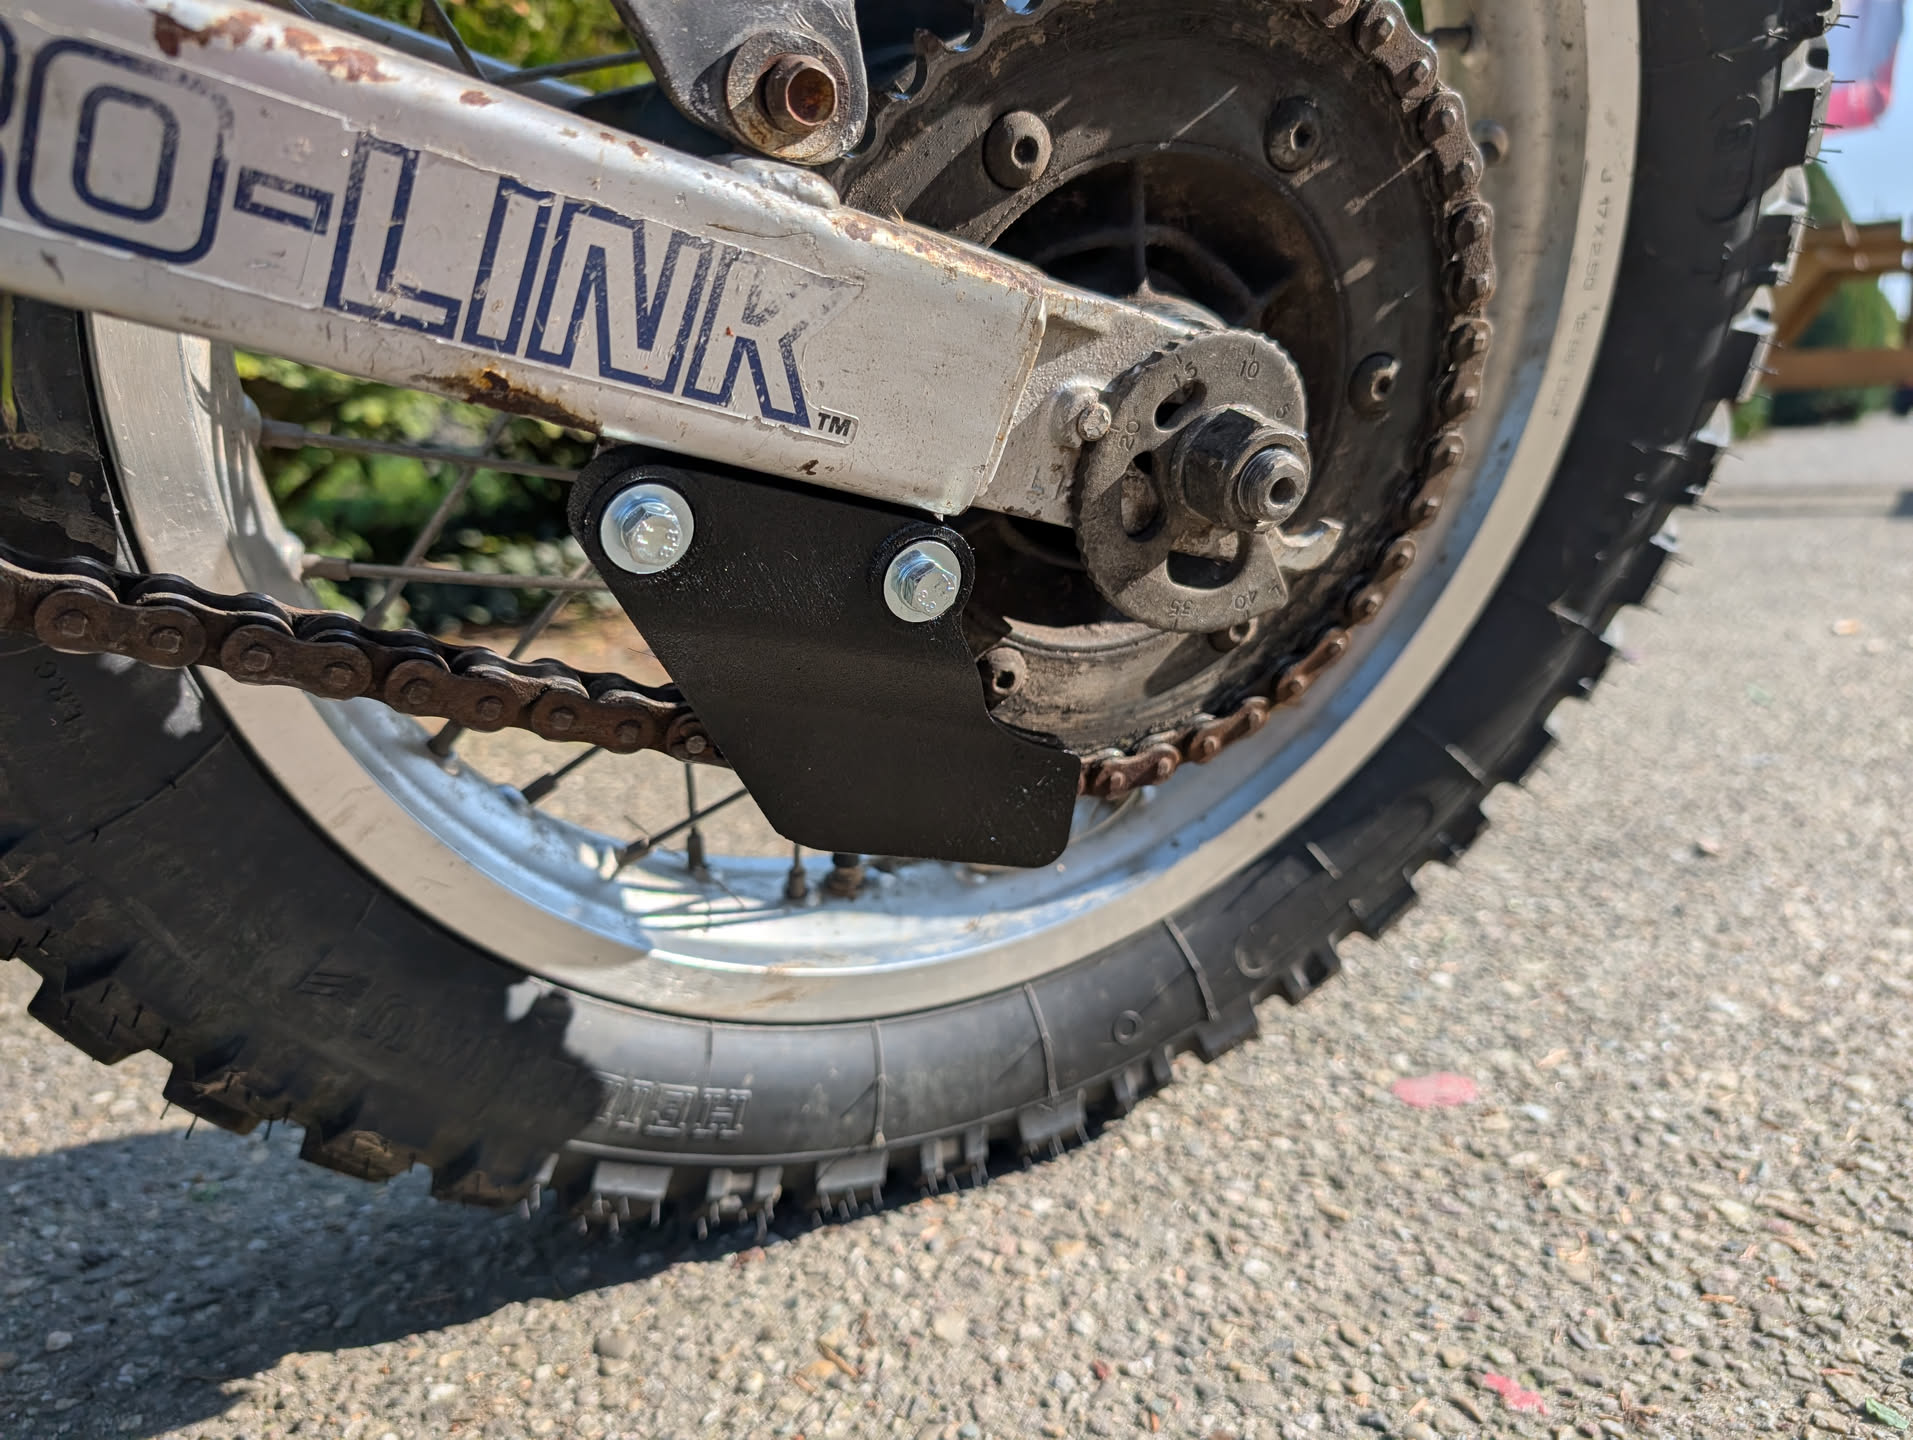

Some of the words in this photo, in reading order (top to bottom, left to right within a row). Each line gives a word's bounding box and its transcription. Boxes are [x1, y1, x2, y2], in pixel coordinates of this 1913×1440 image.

[0, 18, 862, 428] O-LINK
[1172, 361, 1198, 389] 15
[1239, 360, 1260, 379] 10
[817, 411, 852, 437] TM
